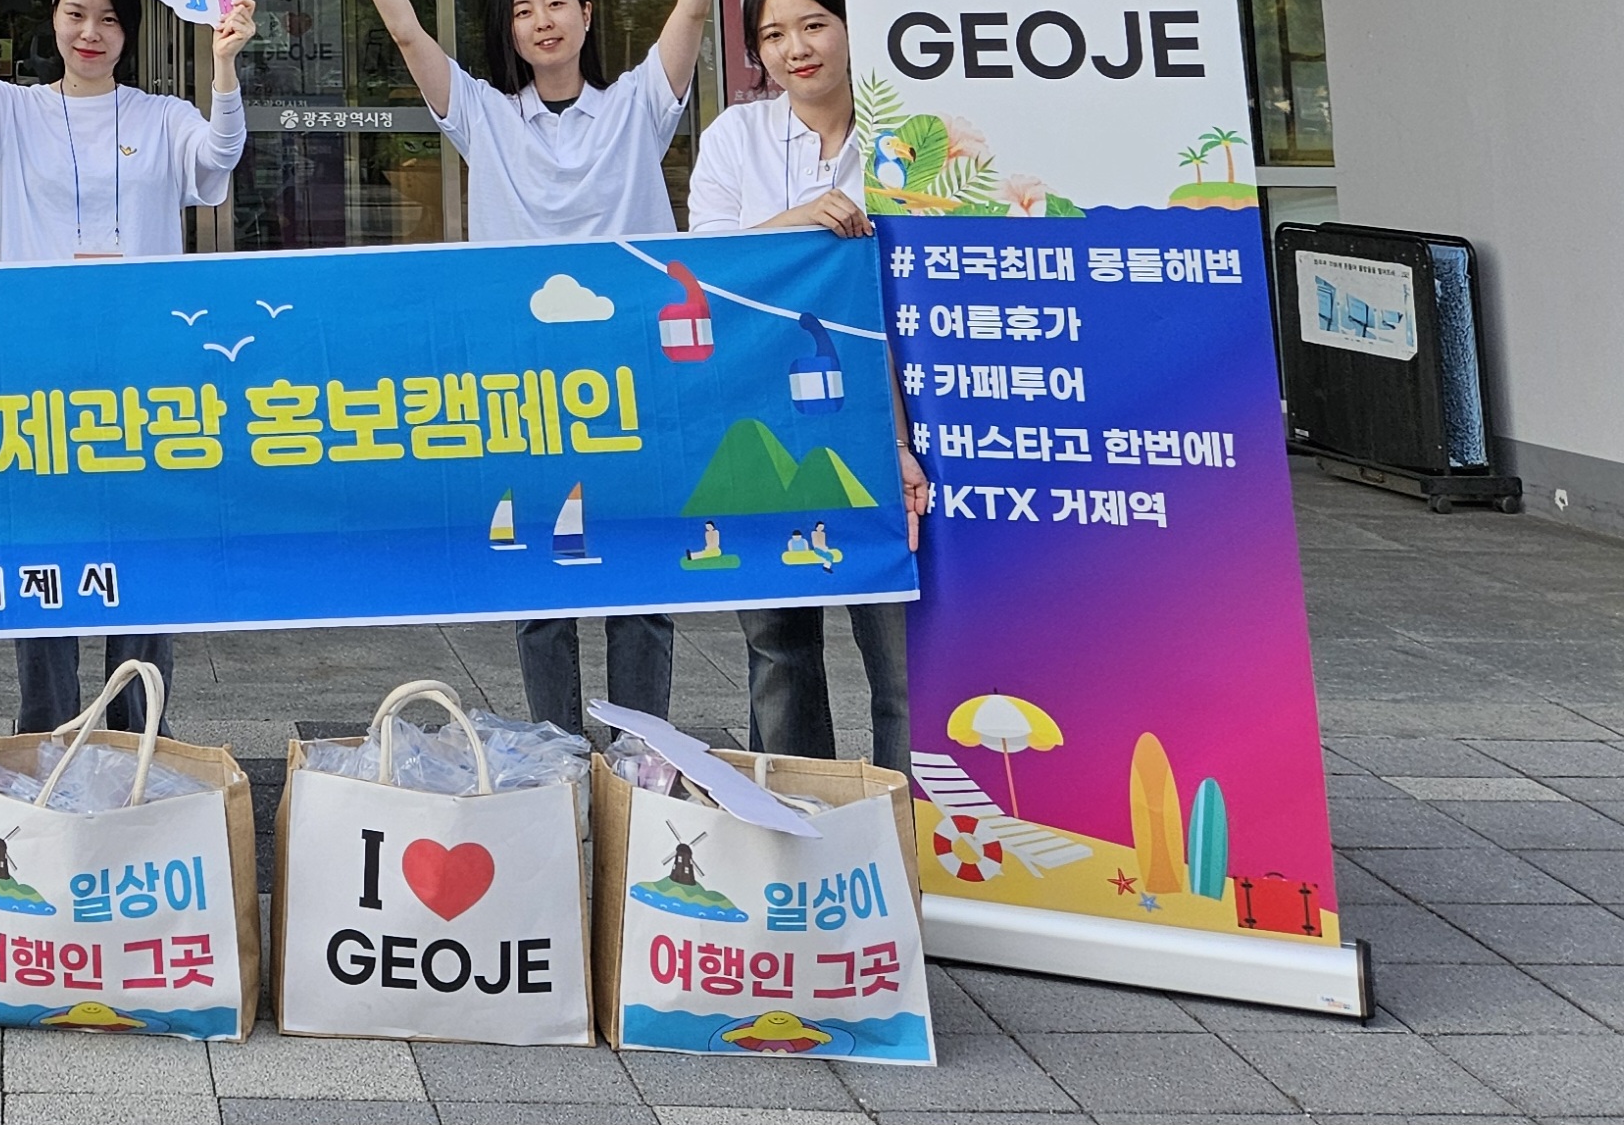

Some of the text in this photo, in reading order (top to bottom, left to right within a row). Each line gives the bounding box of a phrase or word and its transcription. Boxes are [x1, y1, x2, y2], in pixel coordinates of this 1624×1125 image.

[887, 10, 1206, 80] GEOJE
[302, 111, 393, 128] 광주광역시청
[924, 246, 1076, 281] 전국최대
[1088, 248, 1243, 284] 몽돌해변
[930, 304, 1082, 342] 여름휴가
[934, 363, 1086, 402] 카페투어
[245, 365, 643, 467] 홍보캠페인
[938, 424, 1093, 463] 버스타고
[1102, 428, 1237, 468] 한번에!
[943, 485, 1040, 522] KTX
[1051, 489, 1168, 528] 거제역
[69, 856, 207, 923] 일상이
[358, 828, 385, 910] I
[764, 862, 888, 932] 일상이
[122, 932, 215, 990] 그곳
[326, 928, 552, 994] GEOJE
[650, 934, 900, 999] 여행인 그곳
